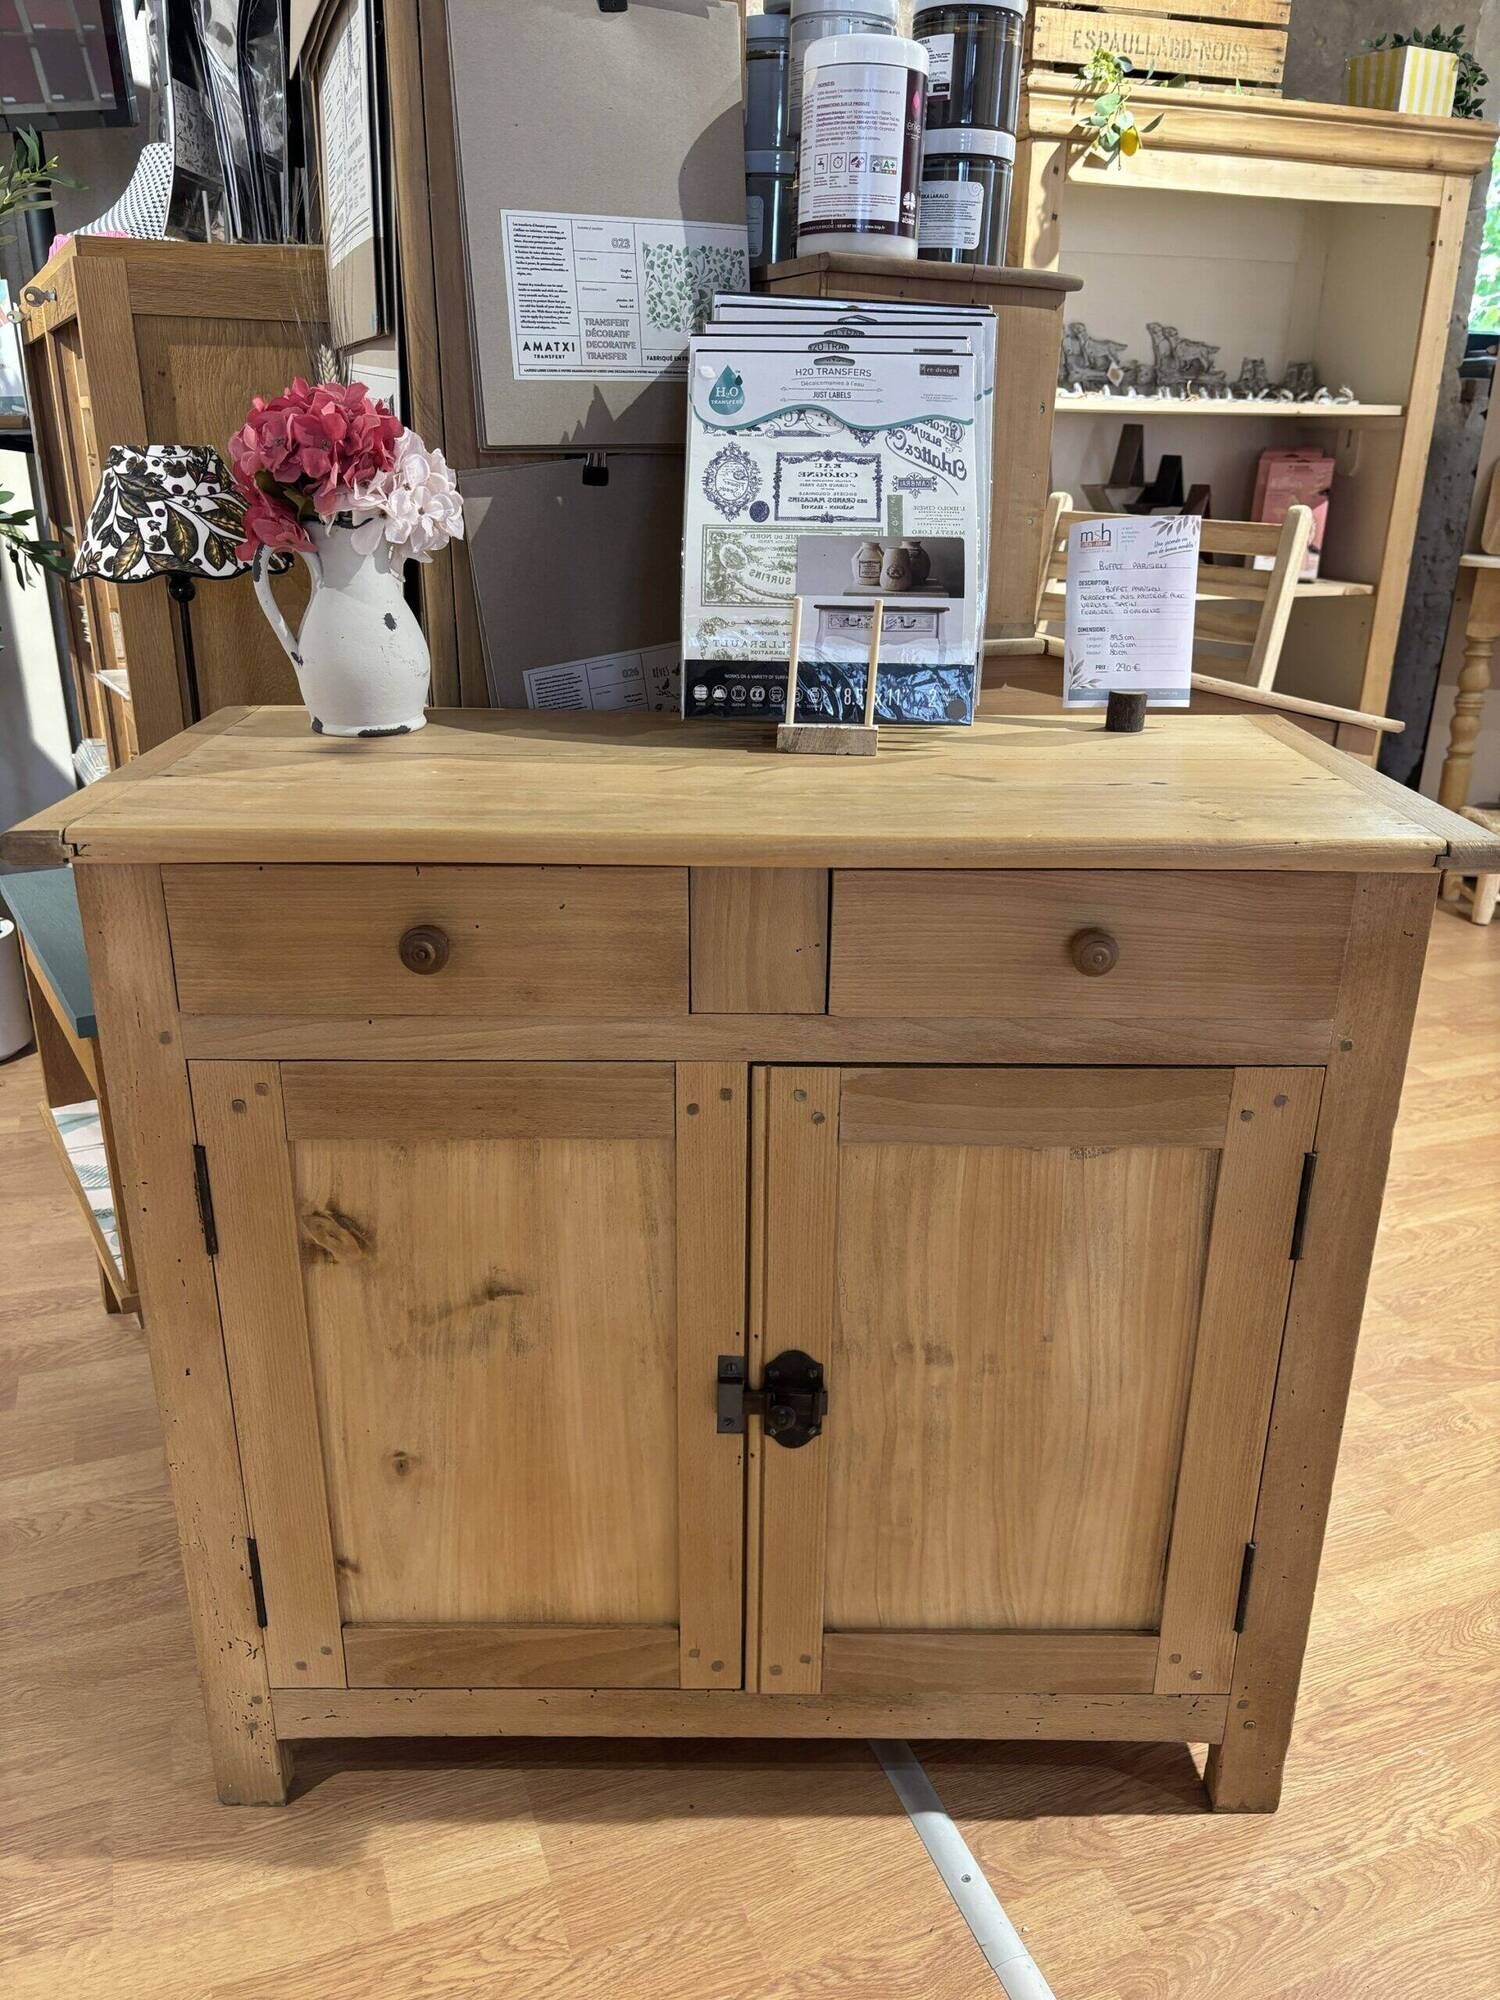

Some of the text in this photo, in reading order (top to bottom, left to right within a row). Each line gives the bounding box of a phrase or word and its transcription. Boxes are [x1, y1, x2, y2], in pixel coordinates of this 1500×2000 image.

[883, 160, 895, 168] A+
[611, 237, 631, 249] 023
[584, 318, 629, 327] TRANSFERT
[585, 328, 630, 339] DÉCORATIF
[523, 341, 575, 352] AMATXI
[586, 340, 637, 350] DECORATIVE
[587, 351, 628, 361] TRANSFER
[816, 367, 872, 377] TRANSFERS
[829, 391, 851, 399] LABELS
[1115, 662, 1131, 672] 290
[1133, 663, 1141, 672] €
